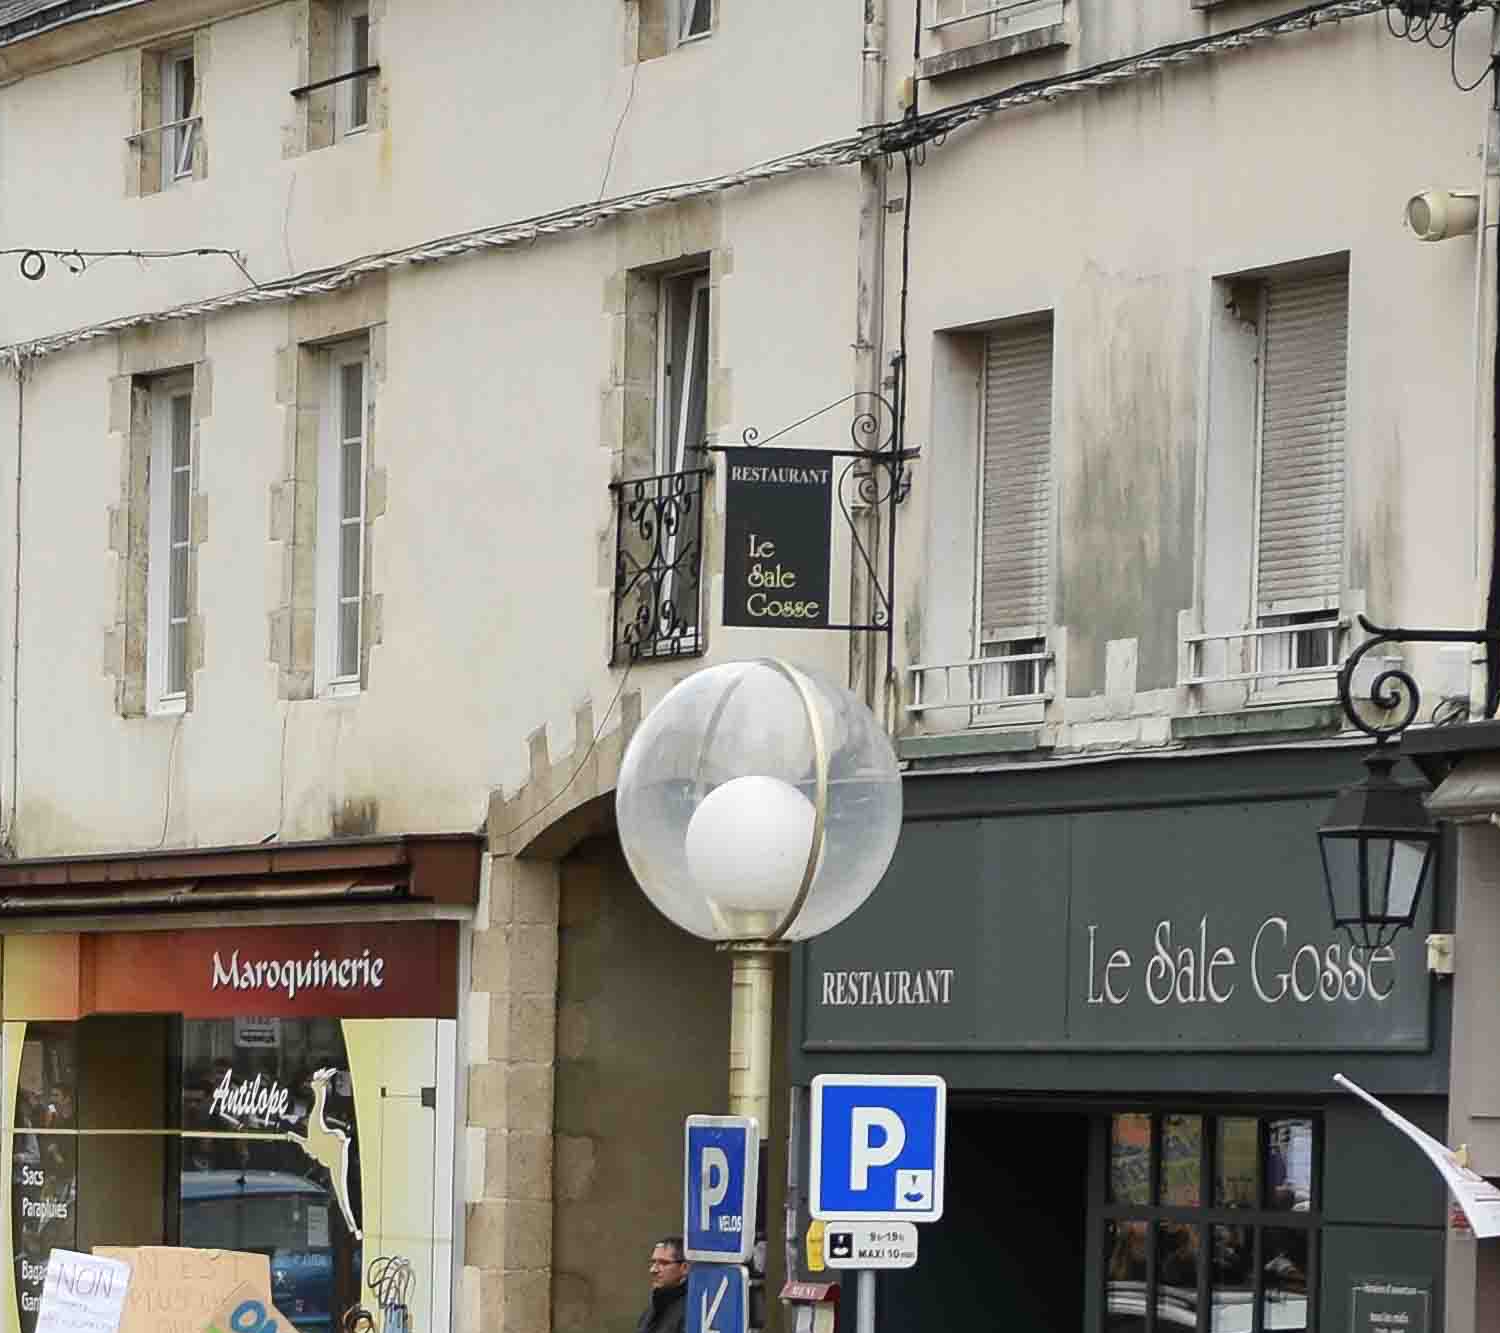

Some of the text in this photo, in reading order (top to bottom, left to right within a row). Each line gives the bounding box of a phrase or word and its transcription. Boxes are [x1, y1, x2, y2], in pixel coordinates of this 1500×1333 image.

[731, 466, 829, 484] RESTAURANT
[749, 534, 775, 558] Le
[748, 563, 796, 588] Sale
[747, 593, 820, 619] Gosse
[212, 949, 384, 1000] Maroquinerie
[1087, 915, 1397, 1004] Le Sale Gosse
[821, 969, 954, 1005] RESTAURANT
[209, 1069, 290, 1127] Antilope
[850, 1106, 907, 1191] P
[22, 1165, 44, 1186] Sacs
[701, 1147, 729, 1231] P
[56, 1263, 116, 1300] NON
